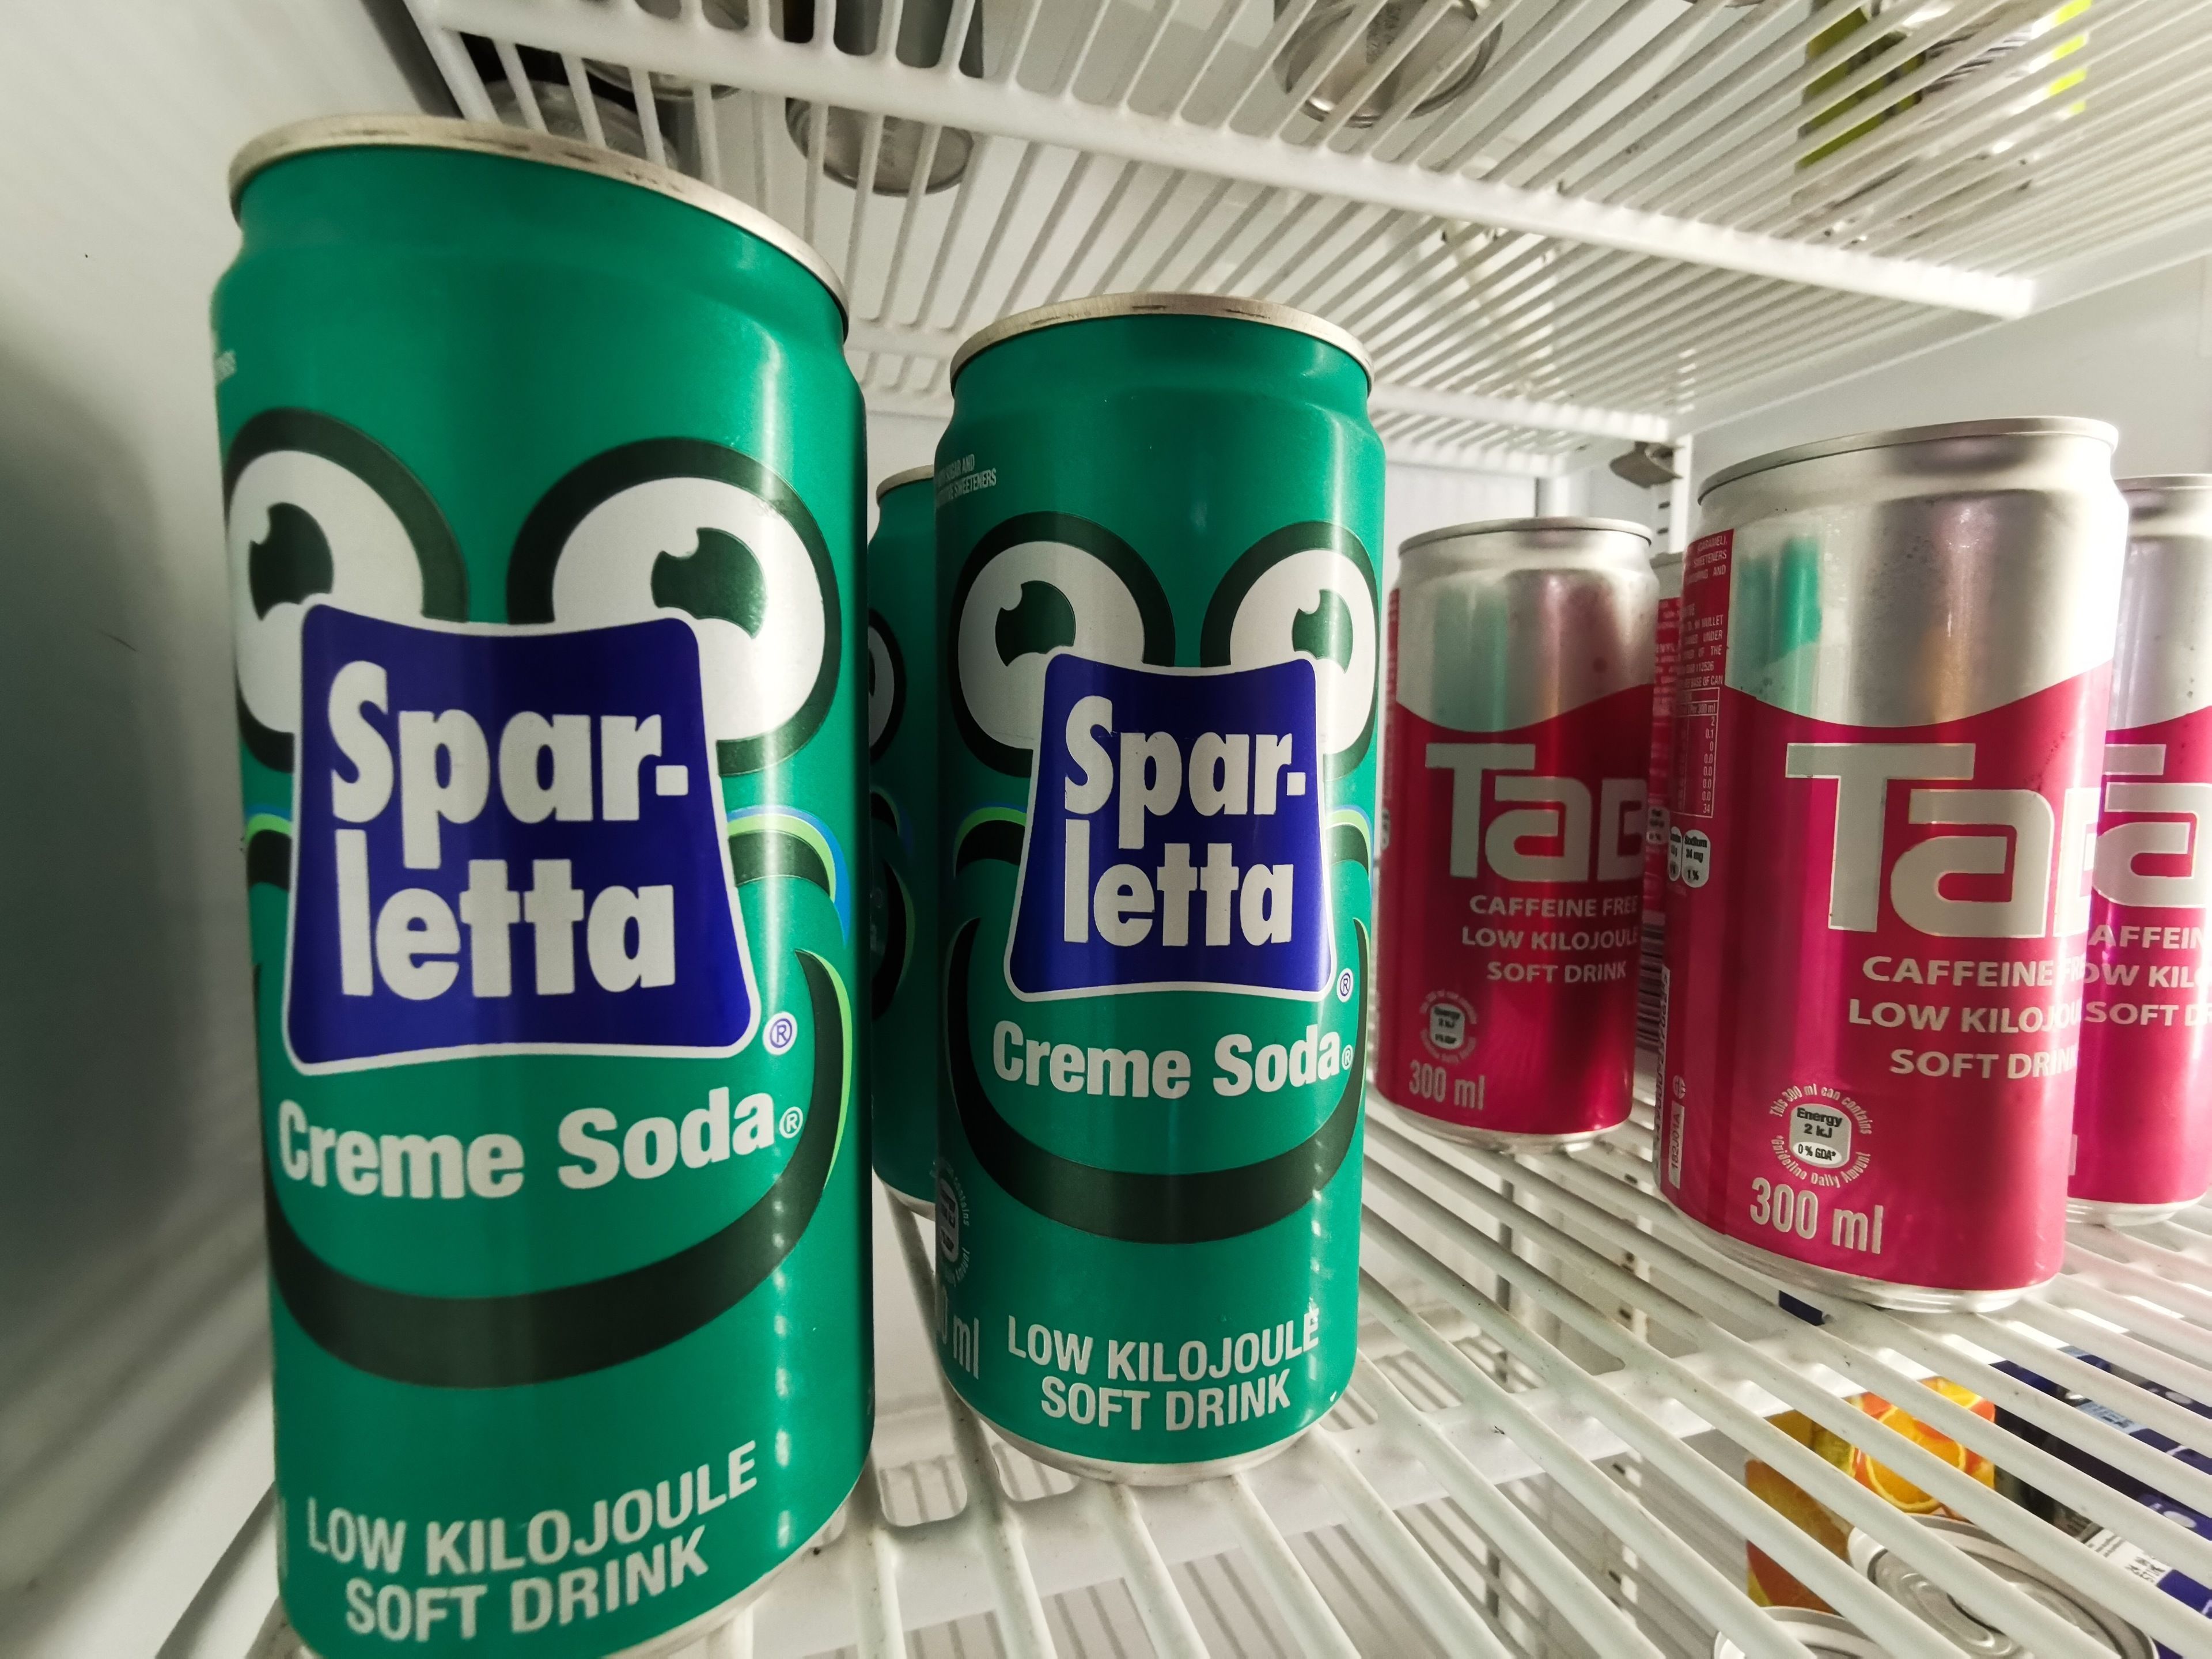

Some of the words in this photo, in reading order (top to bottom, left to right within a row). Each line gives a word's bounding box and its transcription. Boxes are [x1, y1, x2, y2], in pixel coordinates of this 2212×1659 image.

[1711, 645, 1722, 656] THE
[1711, 675, 1724, 686] CAN
[1707, 703, 1715, 714] ml
[1705, 728, 1714, 739] 0.1
[1710, 741, 1714, 752] 0
[1703, 766, 1712, 776] 0.0
[1704, 753, 1713, 764] 0.0
[1063, 819, 1294, 946] letta
[335, 829, 676, 1000] letta
[1469, 895, 1597, 918] CAFFEINE
[1462, 926, 1524, 949] LOW
[1486, 961, 1558, 983] SOFT
[1564, 960, 1627, 983] DRINK
[1861, 955, 2054, 988] CAFFEINE
[1849, 998, 1950, 1032] LOW
[2084, 1001, 2180, 1027] SOFT
[993, 1020, 1191, 1099] Creme
[1213, 1025, 1339, 1097] Soda
[1889, 1048, 1999, 1079] SOFT
[1408, 1059, 1446, 1103] 300
[1453, 1075, 1486, 1111] ml
[1769, 1099, 1788, 1118] This
[1803, 1082, 1817, 1096] ml
[1820, 1086, 1841, 1101] can
[1841, 1096, 1873, 1135] contains
[1796, 1107, 1843, 1128] Energy
[278, 1100, 525, 1199] Creme
[558, 1086, 776, 1190] Soda
[1803, 1123, 1813, 1135] 2
[1815, 1125, 1832, 1138] kJ
[1798, 1143, 1804, 1154] 0
[1805, 1145, 1813, 1157] %
[1810, 1172, 1840, 1188] Daily
[1840, 1152, 1871, 1183] Amount
[1749, 1177, 1819, 1240] 300
[1831, 1204, 1884, 1255] ml
[1008, 1315, 1094, 1375] LOW
[1108, 1306, 1320, 1382] KILOJOULE
[1041, 1376, 1150, 1431] SOFT
[1166, 1368, 1291, 1432] DRINK
[308, 1496, 407, 1574] LOW
[427, 1440, 757, 1576] KILOJOULE
[346, 1577, 488, 1643] SOFT
[510, 1525, 709, 1634] DRINK
